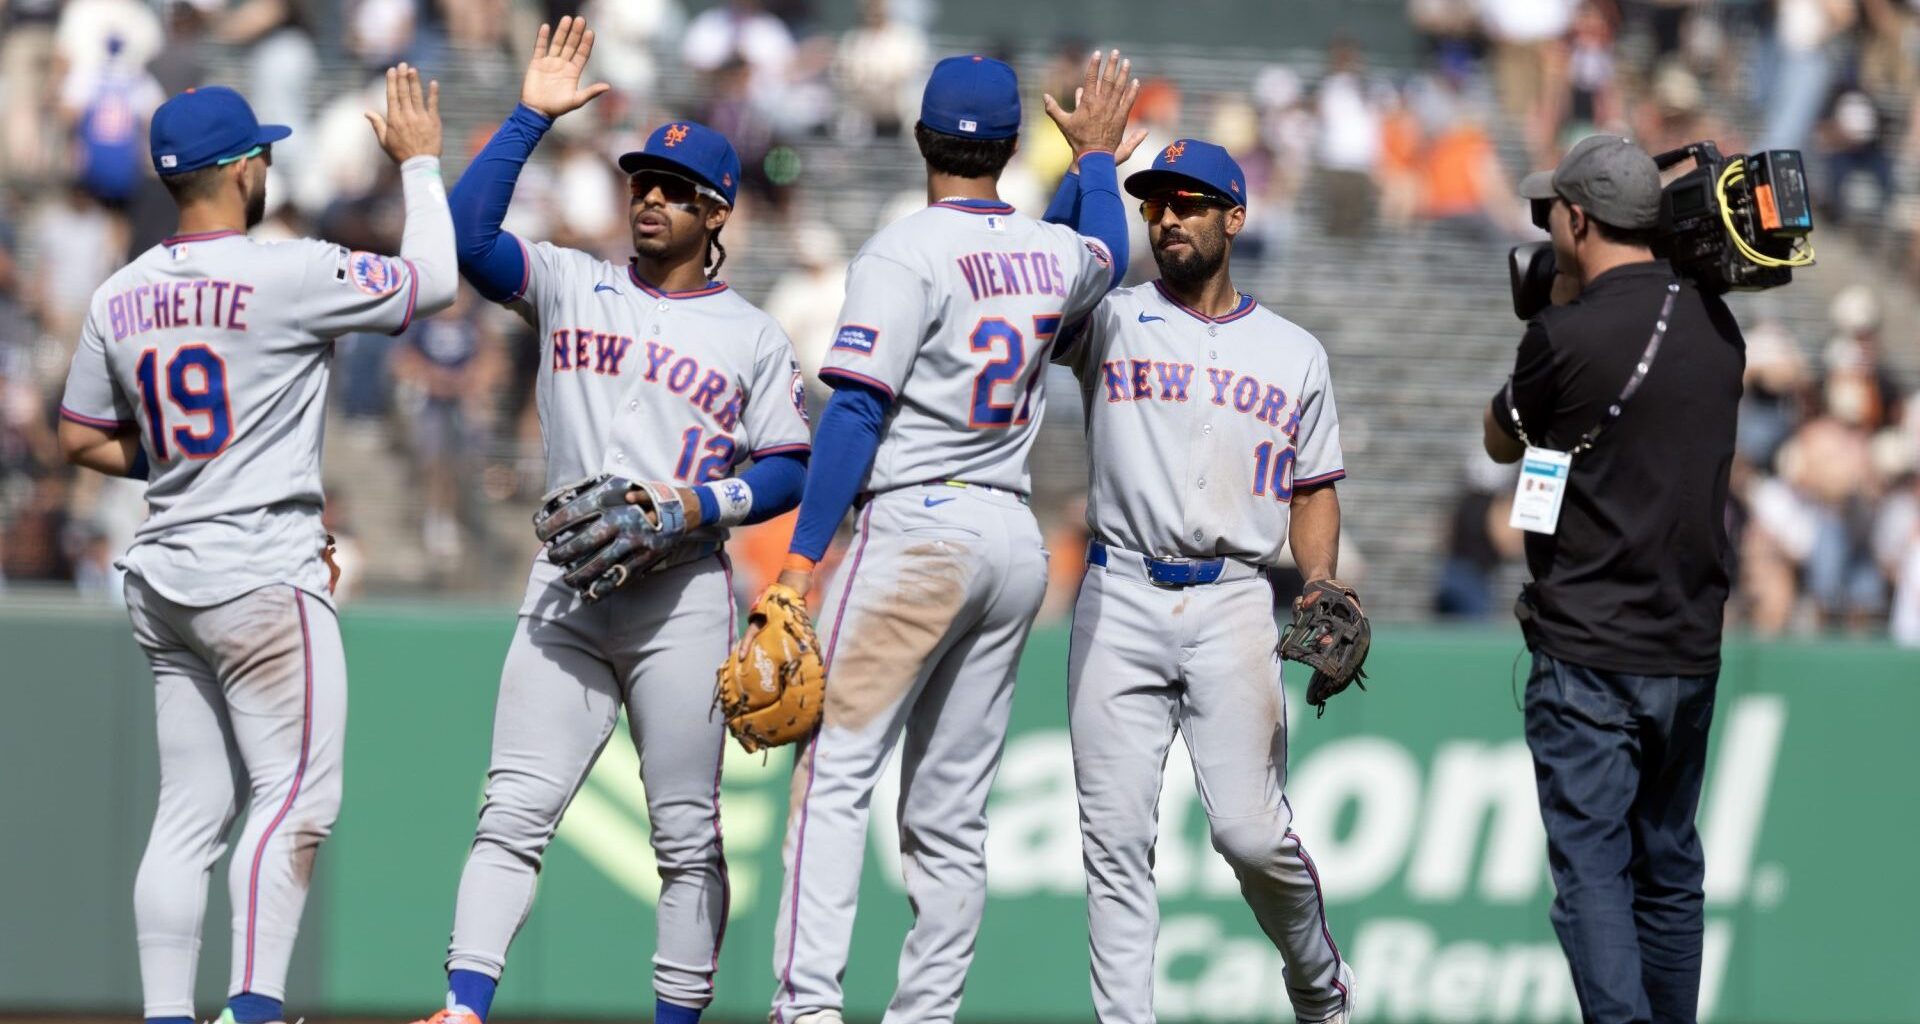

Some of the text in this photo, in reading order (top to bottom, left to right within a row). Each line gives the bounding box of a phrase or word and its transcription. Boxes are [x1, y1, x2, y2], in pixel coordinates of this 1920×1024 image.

[957, 252, 1069, 301] VIENTOS
[109, 281, 254, 343] BICHETTE
[552, 328, 633, 377] NEW
[968, 313, 1064, 430] 27
[1102, 359, 1195, 403] NEW
[136, 343, 235, 462] 19
[674, 425, 737, 486] 12
[1253, 441, 1296, 503] 10
[1350, 916, 1735, 1022] Renl
